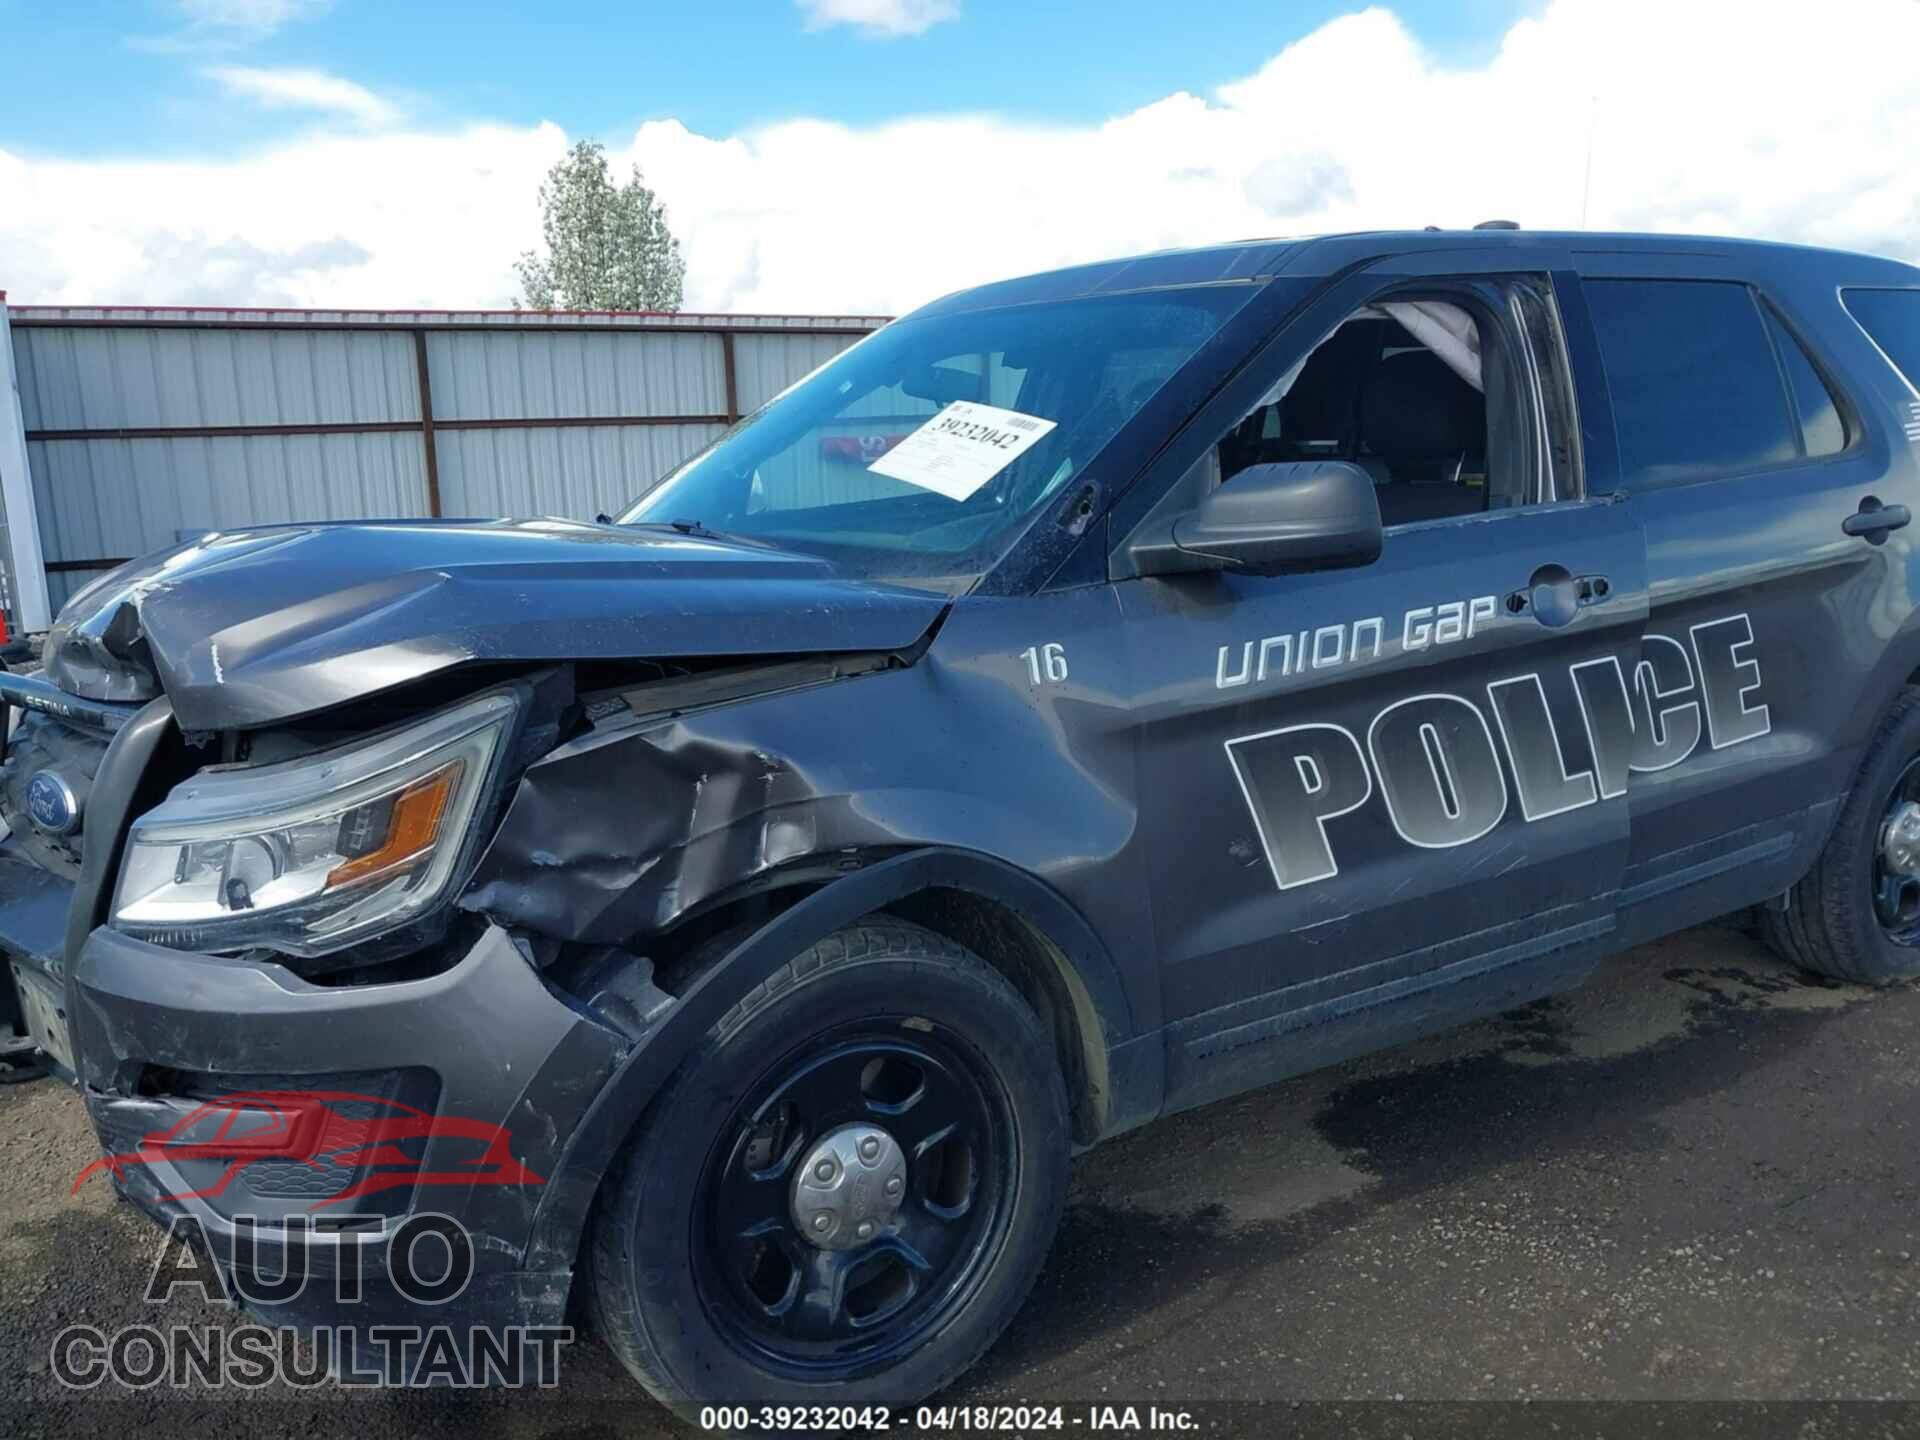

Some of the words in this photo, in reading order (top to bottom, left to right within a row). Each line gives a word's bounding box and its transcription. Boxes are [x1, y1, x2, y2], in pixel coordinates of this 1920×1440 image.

[932, 418, 1019, 449] 39232042
[1019, 642, 1069, 685] 16
[1224, 613, 1770, 889] POLICE
